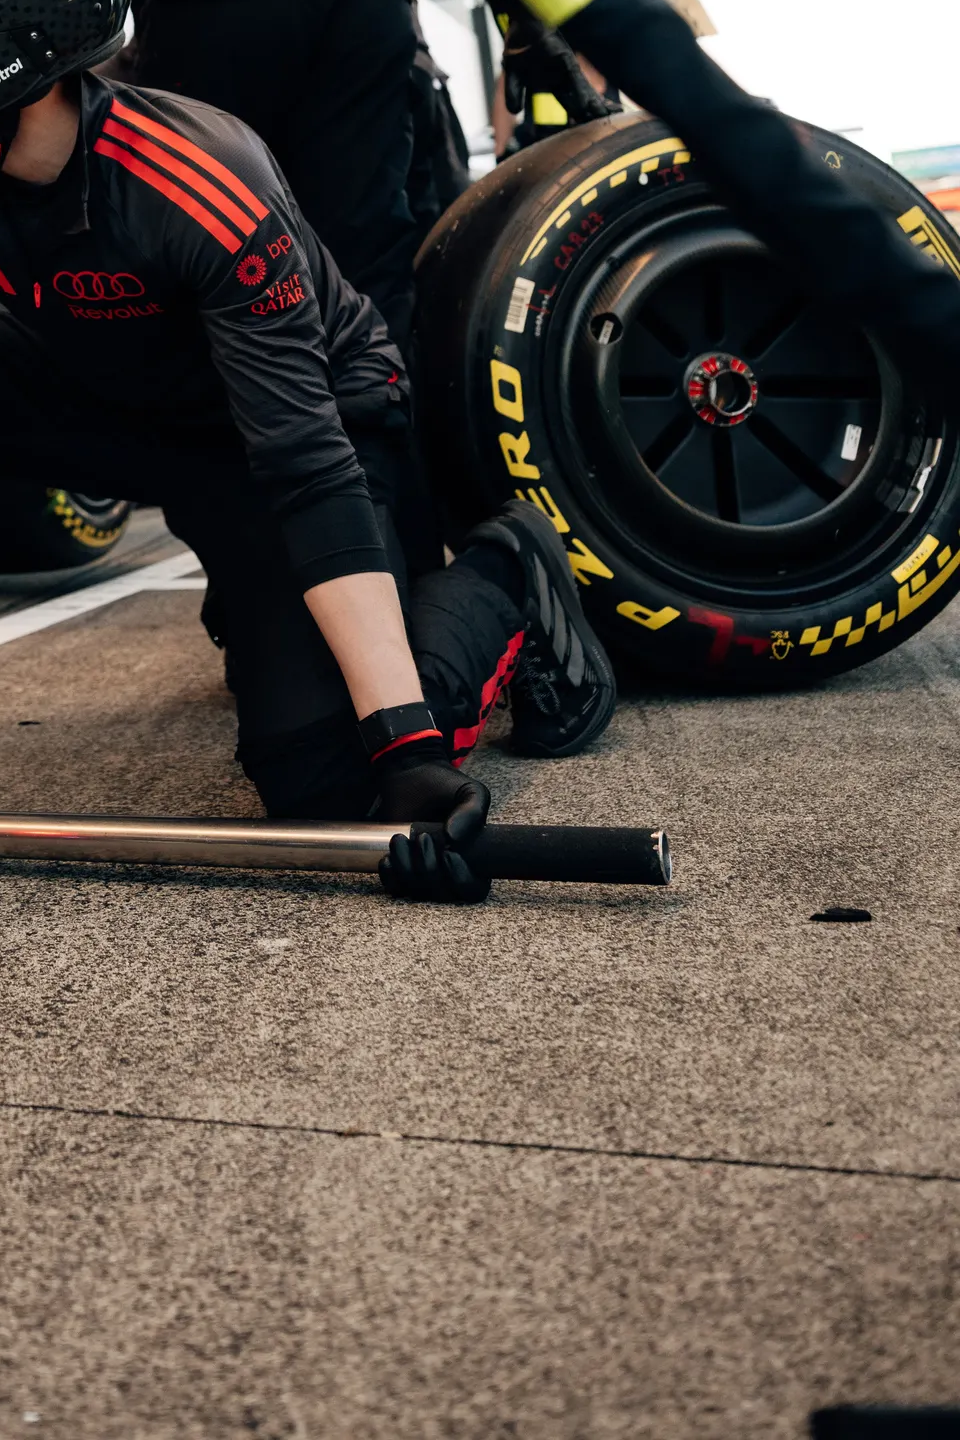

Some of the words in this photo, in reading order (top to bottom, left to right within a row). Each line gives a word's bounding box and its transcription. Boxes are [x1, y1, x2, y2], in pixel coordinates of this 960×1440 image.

[266, 233, 293, 259] bp
[266, 273, 300, 298] visit
[68, 303, 164, 320] Revolut
[251, 287, 305, 316] QATAR
